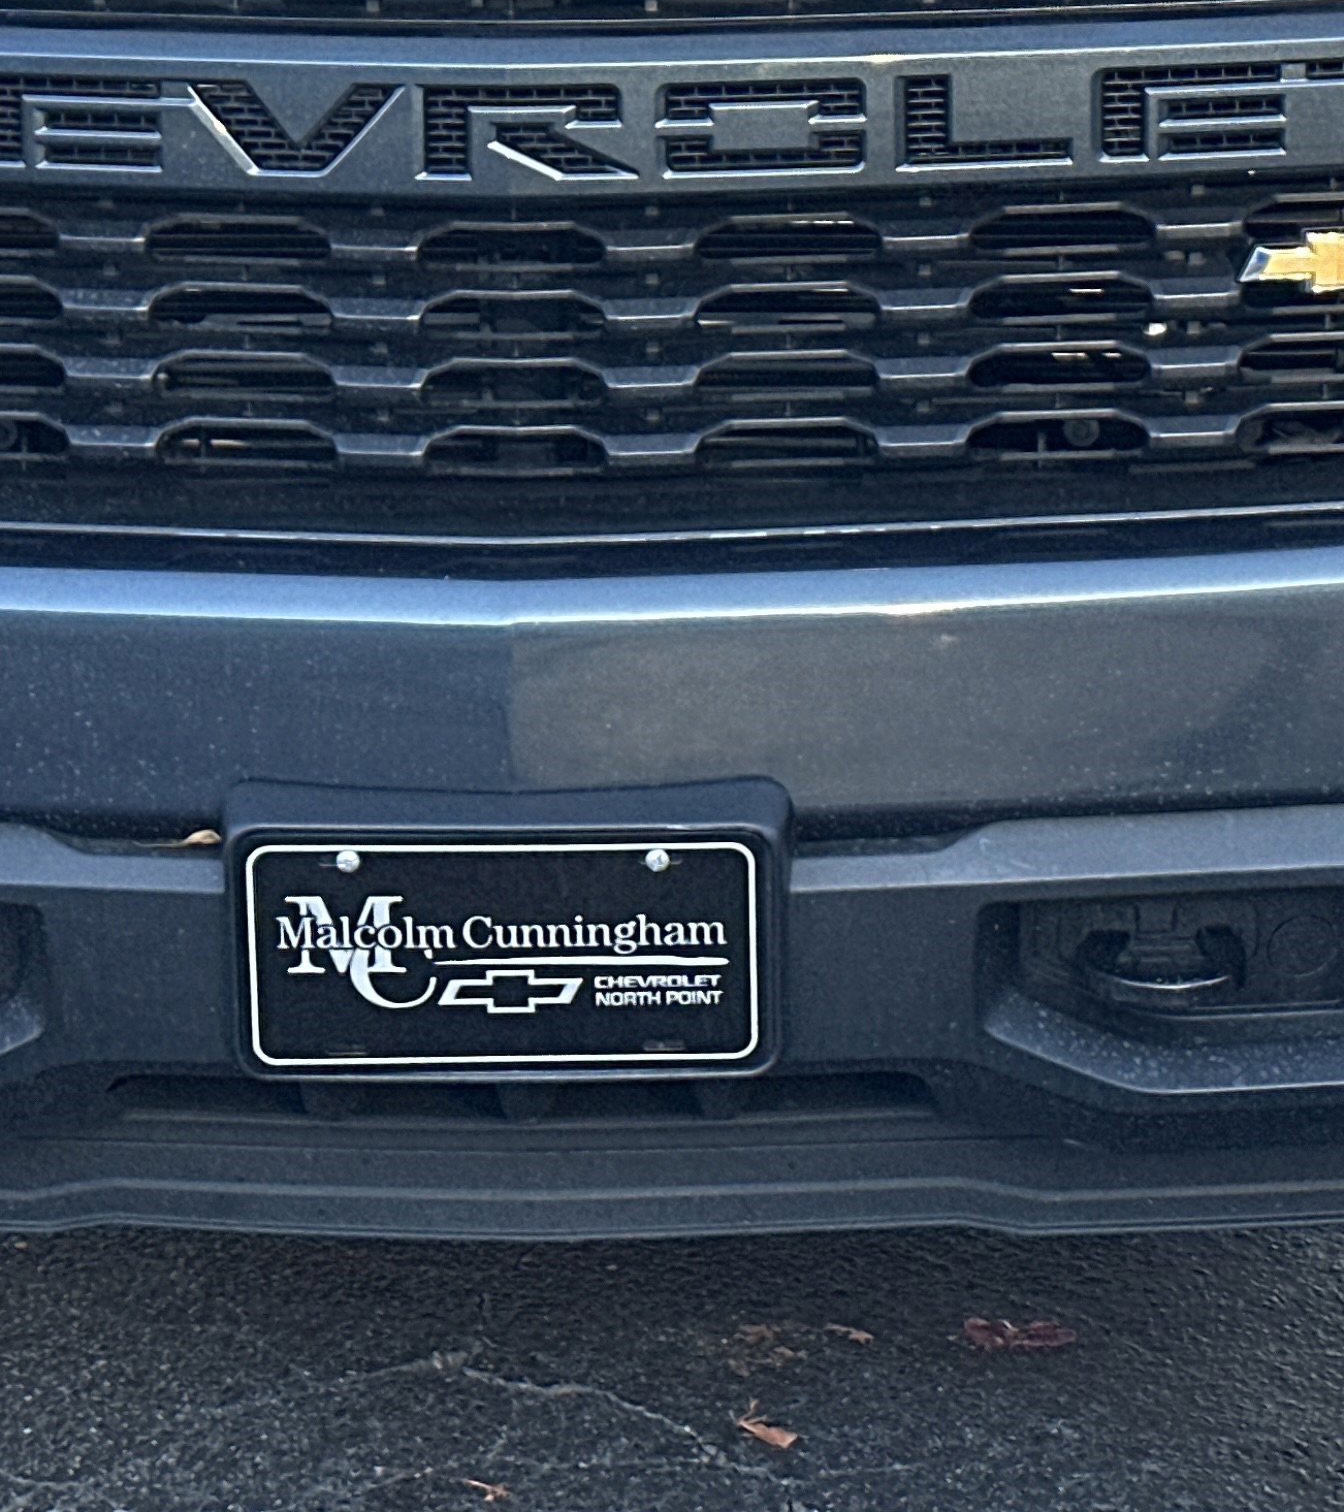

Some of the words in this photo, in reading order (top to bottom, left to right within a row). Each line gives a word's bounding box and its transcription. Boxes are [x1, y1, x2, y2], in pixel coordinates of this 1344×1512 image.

[275, 915, 457, 950] Malcolm
[462, 913, 728, 955] Cunningham
[594, 974, 723, 989] CHEVROLET
[595, 990, 661, 1007] NORTH
[665, 990, 724, 1005] POINT
